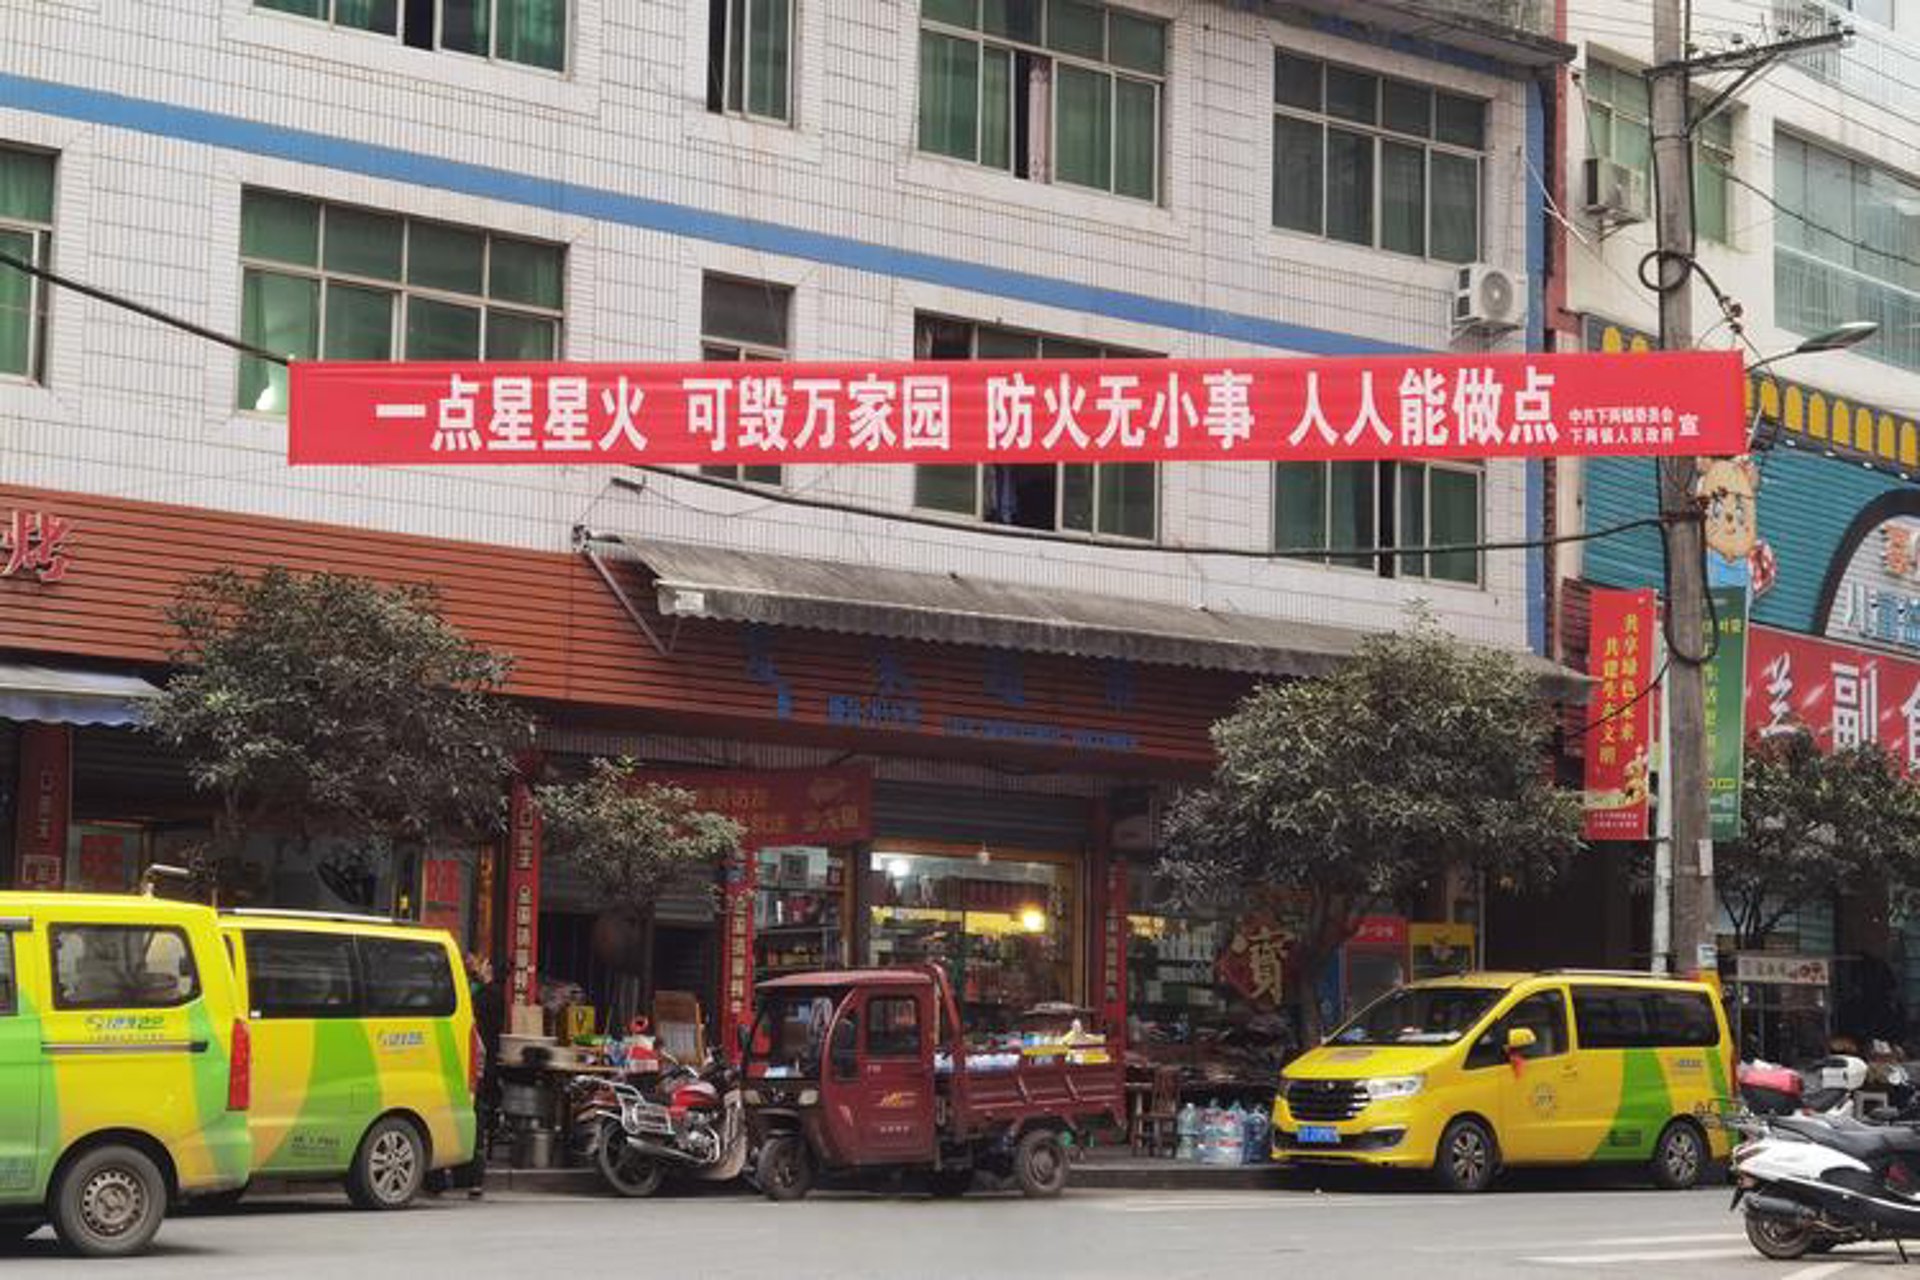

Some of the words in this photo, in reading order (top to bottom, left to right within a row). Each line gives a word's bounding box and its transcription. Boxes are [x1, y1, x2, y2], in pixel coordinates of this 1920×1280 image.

[375, 374, 646, 453] 一点星星火
[684, 374, 951, 452] 可毁万家园
[986, 371, 1256, 451] 防火无小事
[1287, 366, 1560, 447] 人人能做点
[1678, 412, 1702, 437] 宣
[2, 510, 72, 581] 烤
